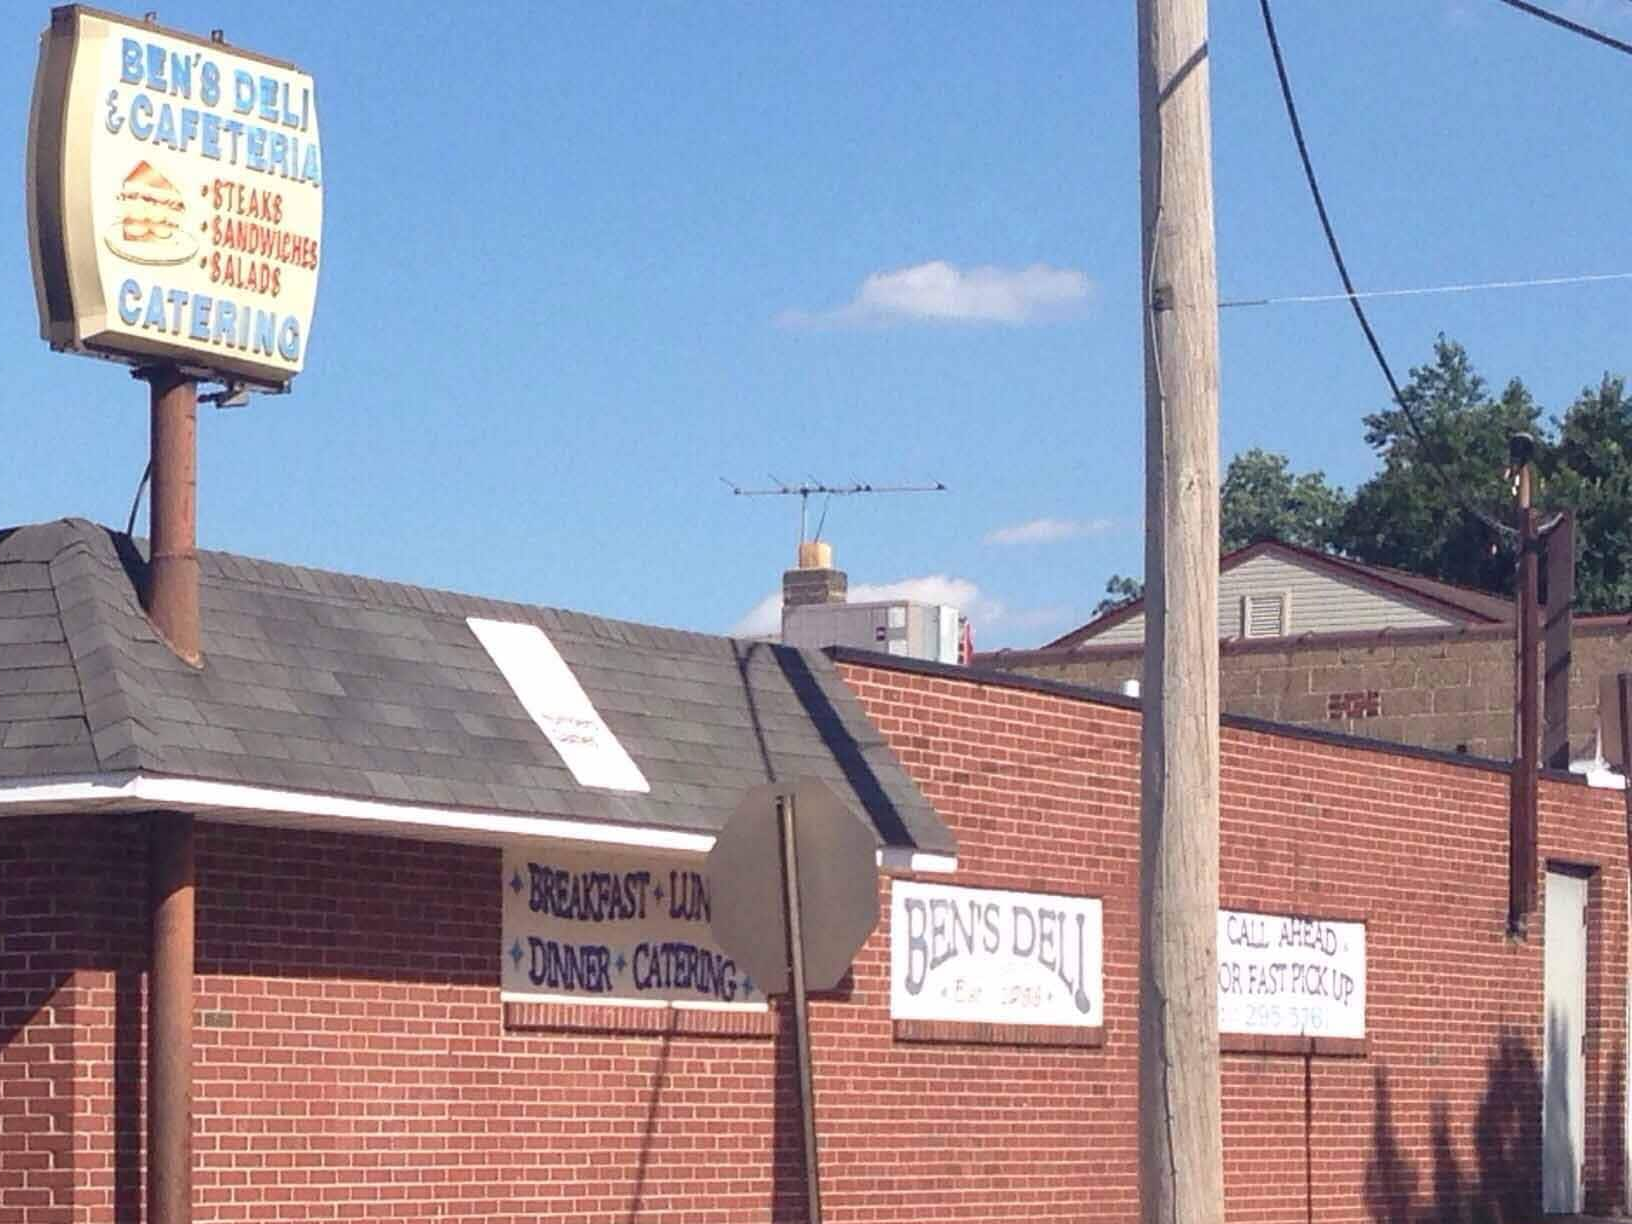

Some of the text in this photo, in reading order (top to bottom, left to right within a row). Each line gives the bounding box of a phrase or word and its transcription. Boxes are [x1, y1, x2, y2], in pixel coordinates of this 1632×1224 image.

[120, 37, 310, 132] BEN'S DELI
[128, 93, 321, 188] CAFETERIA
[212, 178, 284, 225] STEAKS
[211, 215, 319, 271] SANDWICHES
[210, 252, 282, 297] SALADS
[119, 278, 301, 362] CATERING
[527, 863, 711, 923] BREAKFAST LUN
[904, 897, 1091, 1014] BEN'S DELI
[1227, 915, 1338, 957] CALL AHEAD
[528, 937, 737, 1002] DINNER CATERING
[1218, 962, 1355, 1007] OR FAST PICK UP
